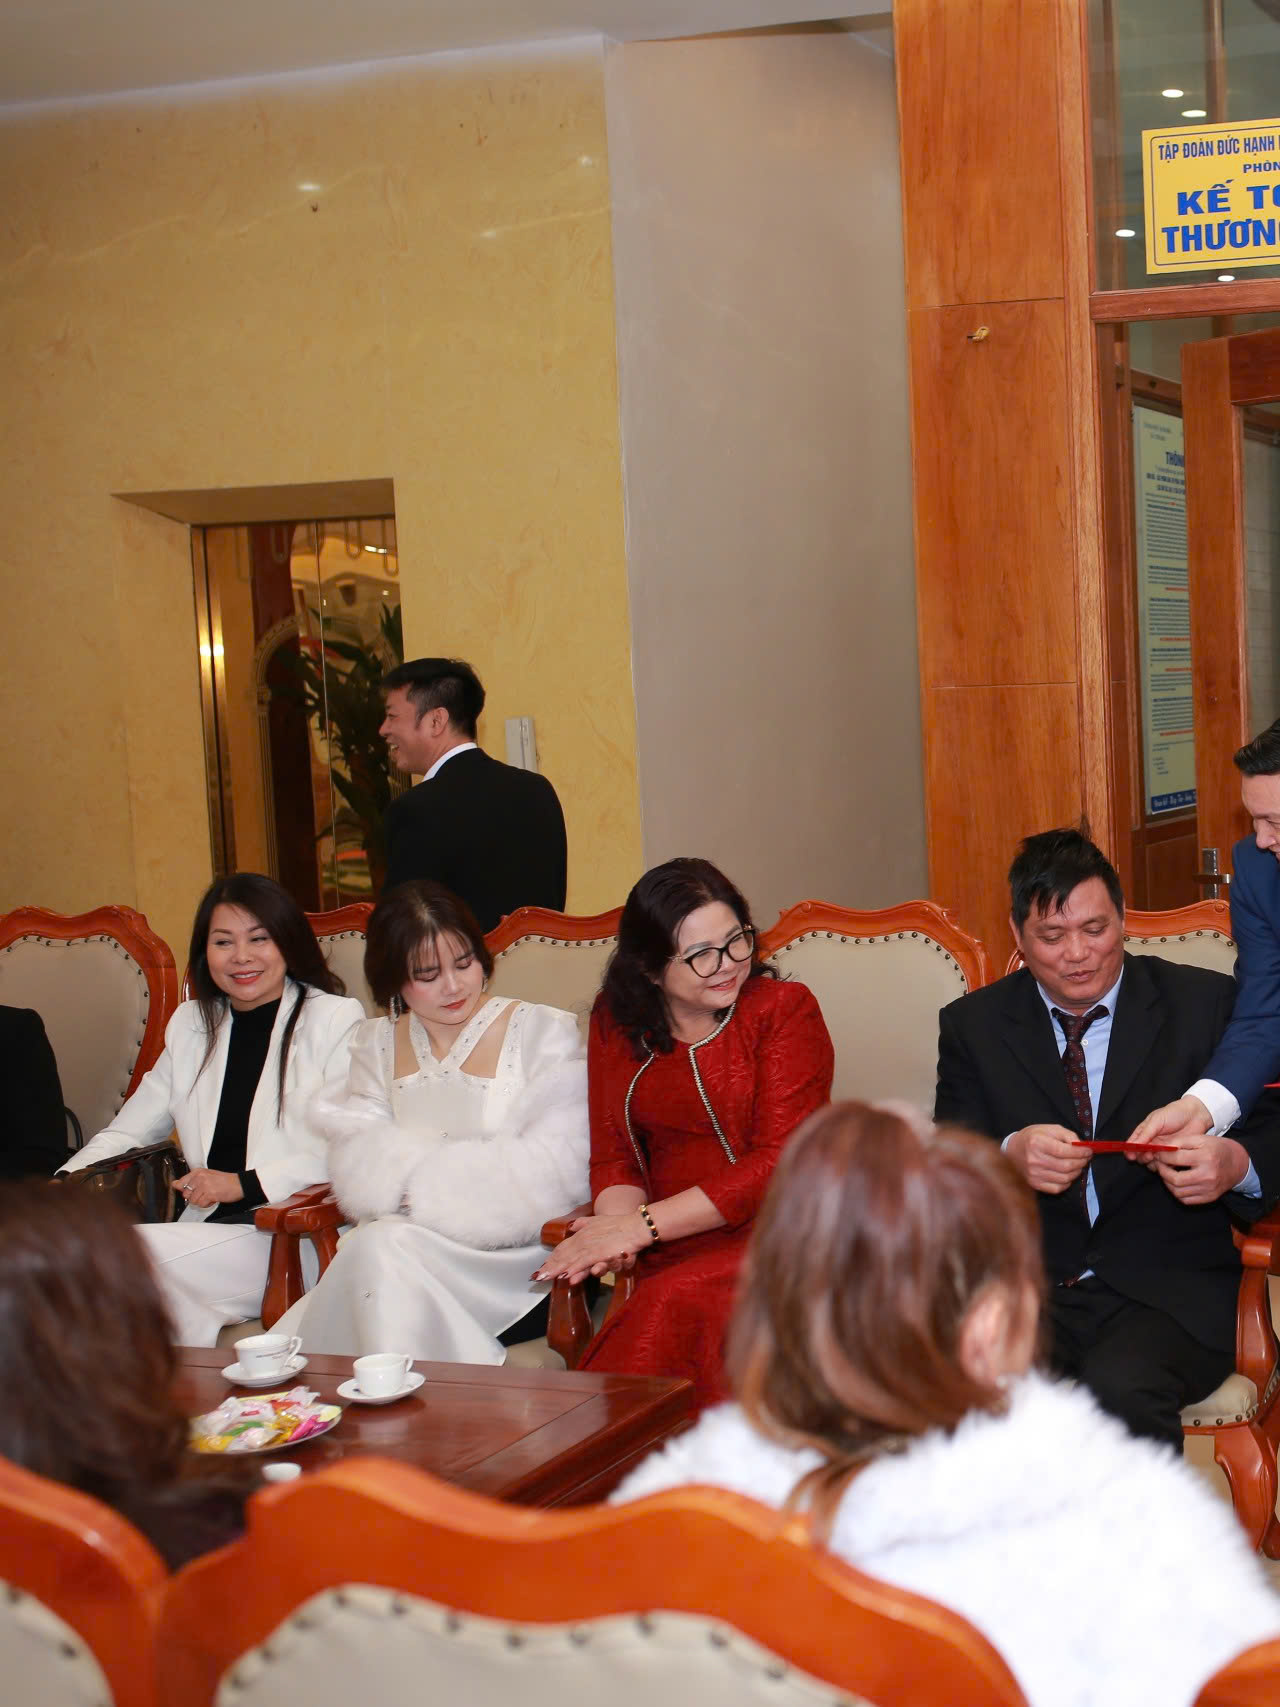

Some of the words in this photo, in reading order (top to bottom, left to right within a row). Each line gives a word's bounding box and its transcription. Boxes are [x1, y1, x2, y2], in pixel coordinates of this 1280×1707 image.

[1158, 141, 1179, 163] TẬP
[1182, 138, 1214, 158] ĐOÀN
[1217, 134, 1240, 155] ĐỨC
[1243, 135, 1275, 156] HẠNH
[1177, 179, 1234, 216] KẾ
